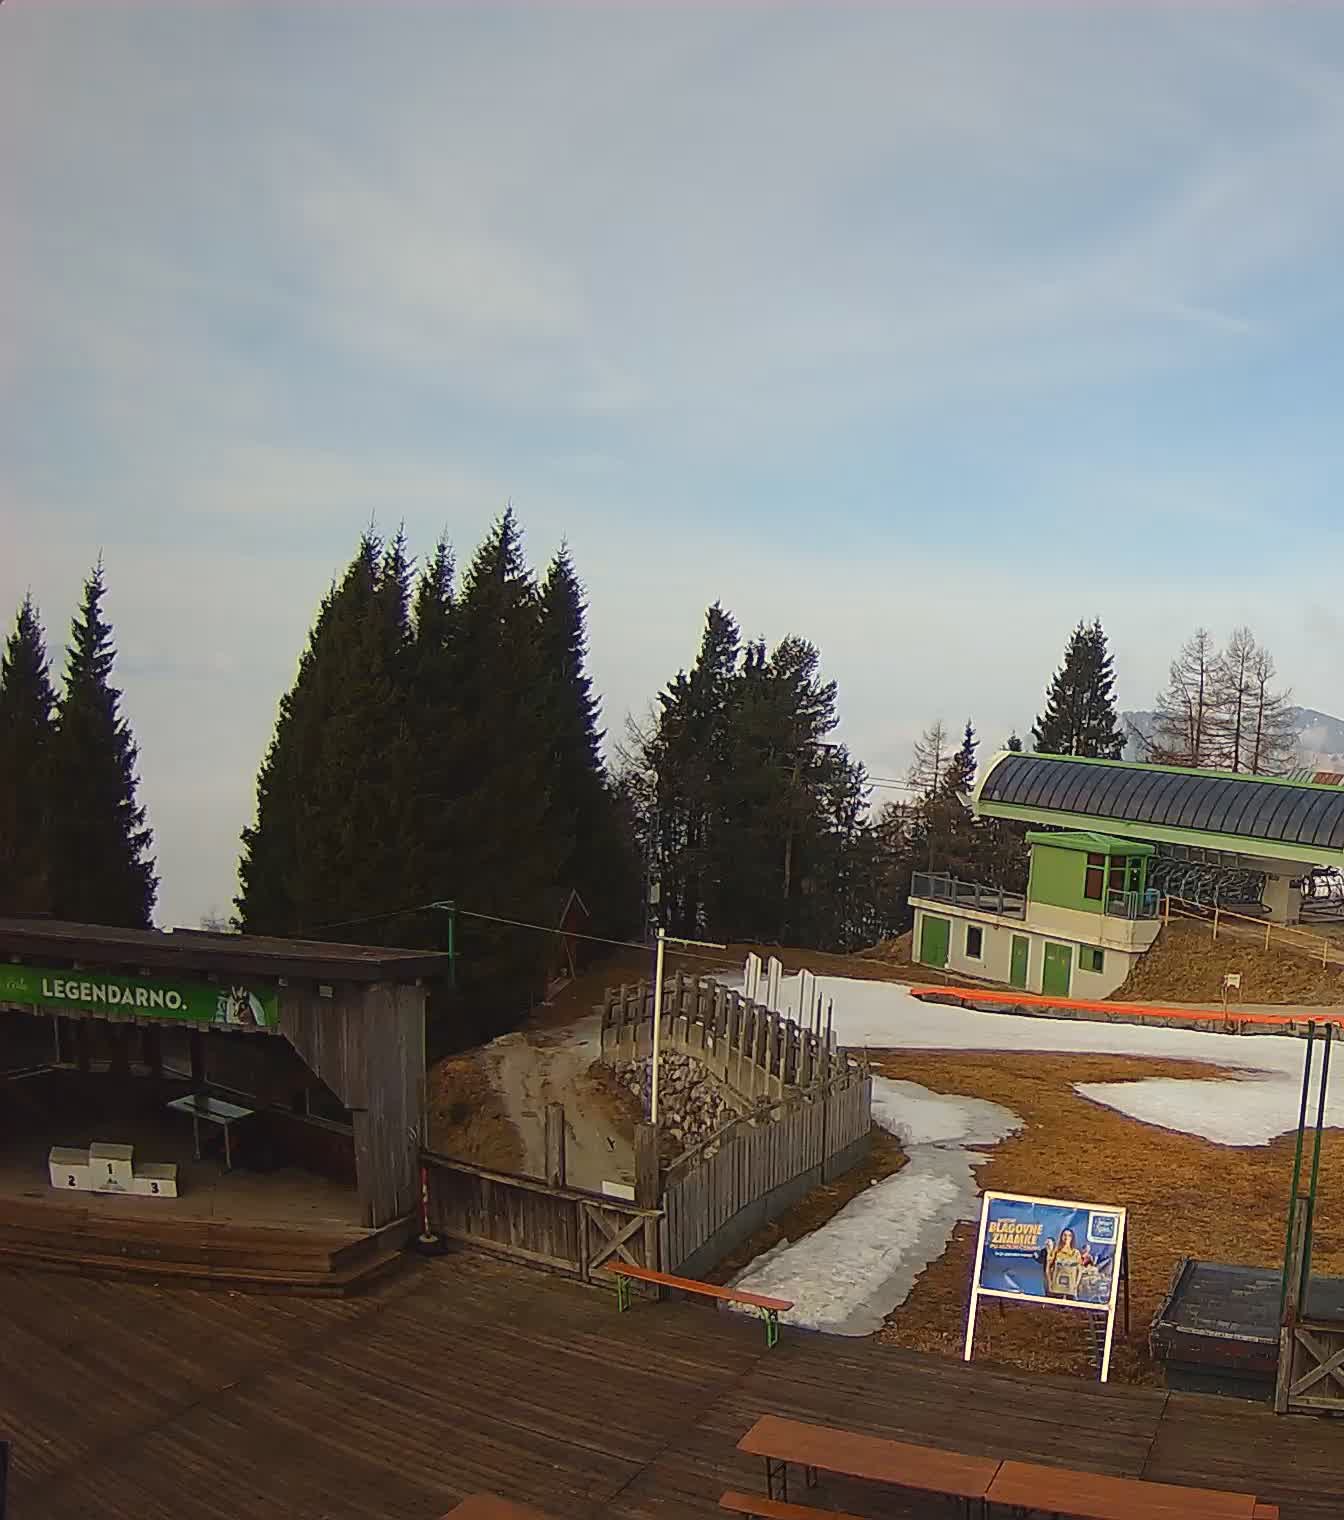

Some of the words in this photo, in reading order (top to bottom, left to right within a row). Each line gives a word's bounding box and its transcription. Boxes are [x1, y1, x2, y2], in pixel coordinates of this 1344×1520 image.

[42, 977, 188, 1011] LEGENDARNO.
[107, 1163, 113, 1175] 1
[68, 1175, 76, 1187] 2
[150, 1182, 159, 1194] 3
[989, 1222, 1044, 1236] BLAGOVNE
[991, 1233, 1038, 1245] ZNAMKE
